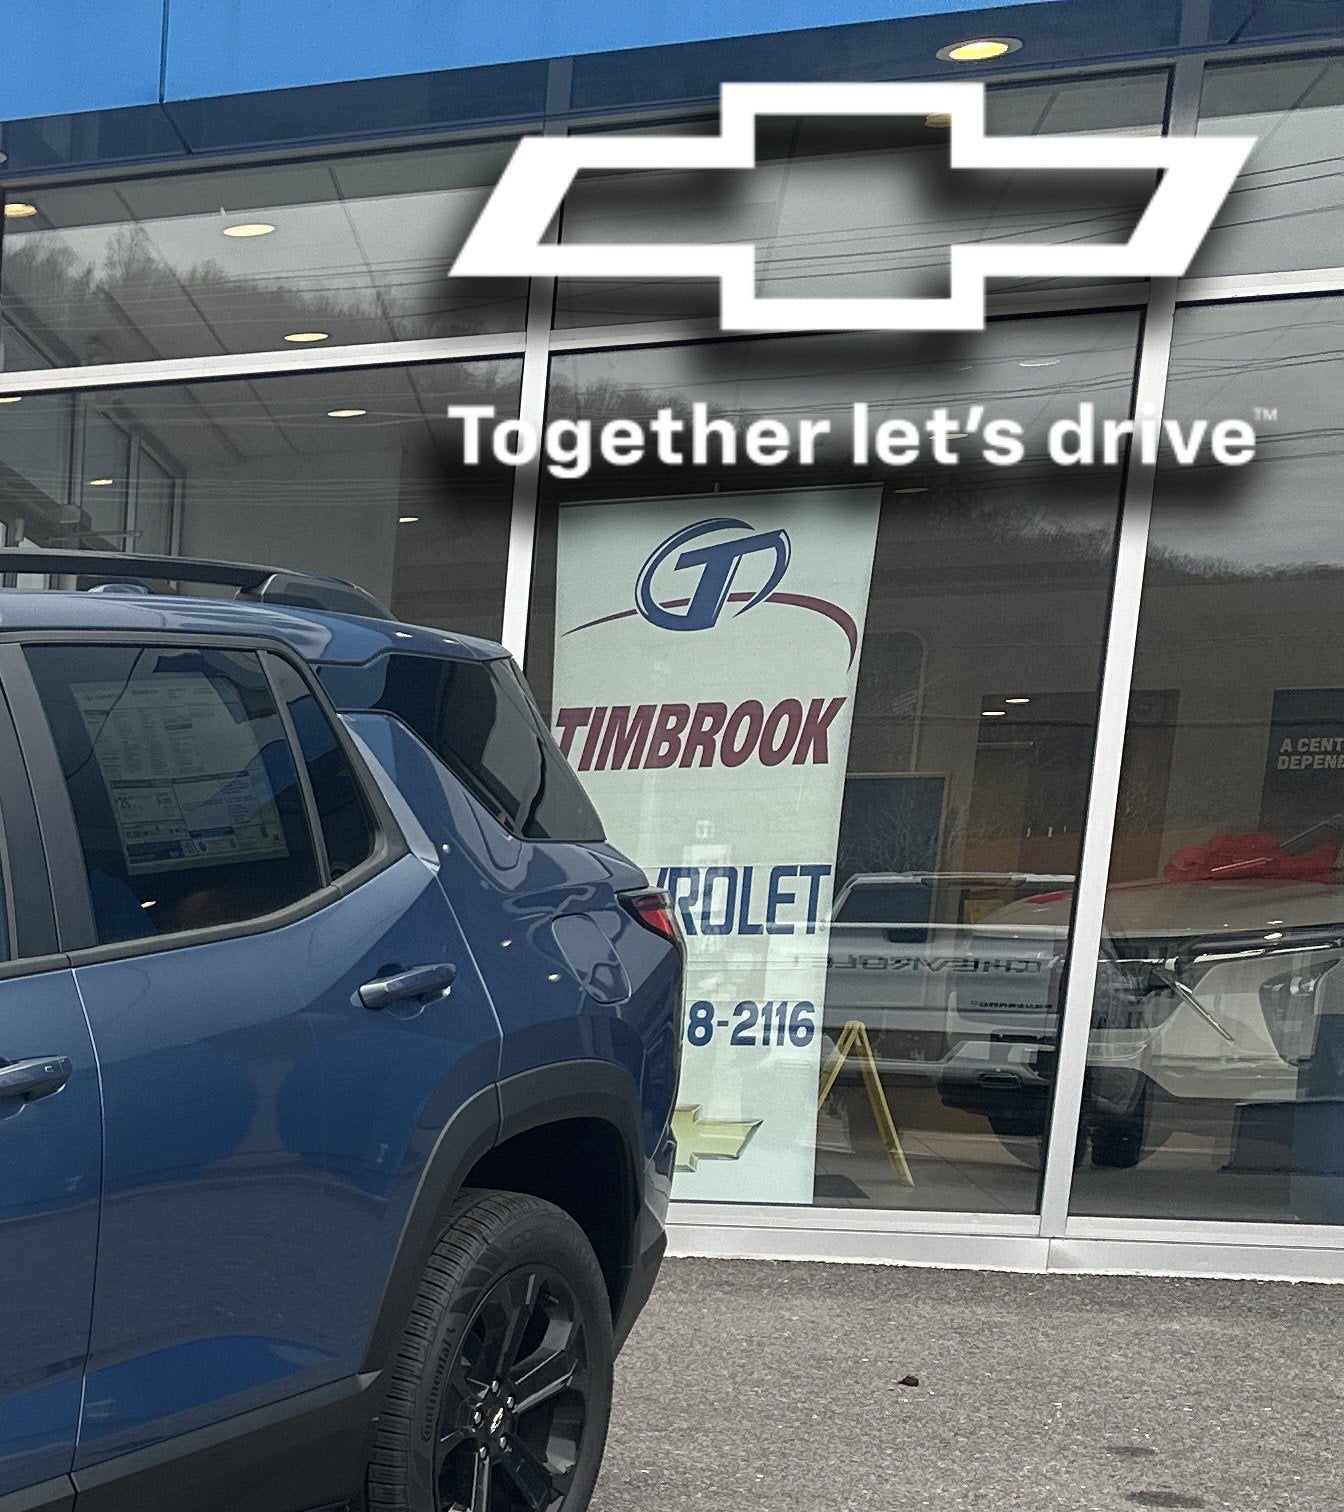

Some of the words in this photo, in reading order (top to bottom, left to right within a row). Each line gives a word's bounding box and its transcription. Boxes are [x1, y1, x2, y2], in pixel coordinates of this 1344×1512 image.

[556, 697, 848, 772] TIMBROOK
[1279, 737, 1293, 753] A
[657, 864, 833, 937] ROLET
